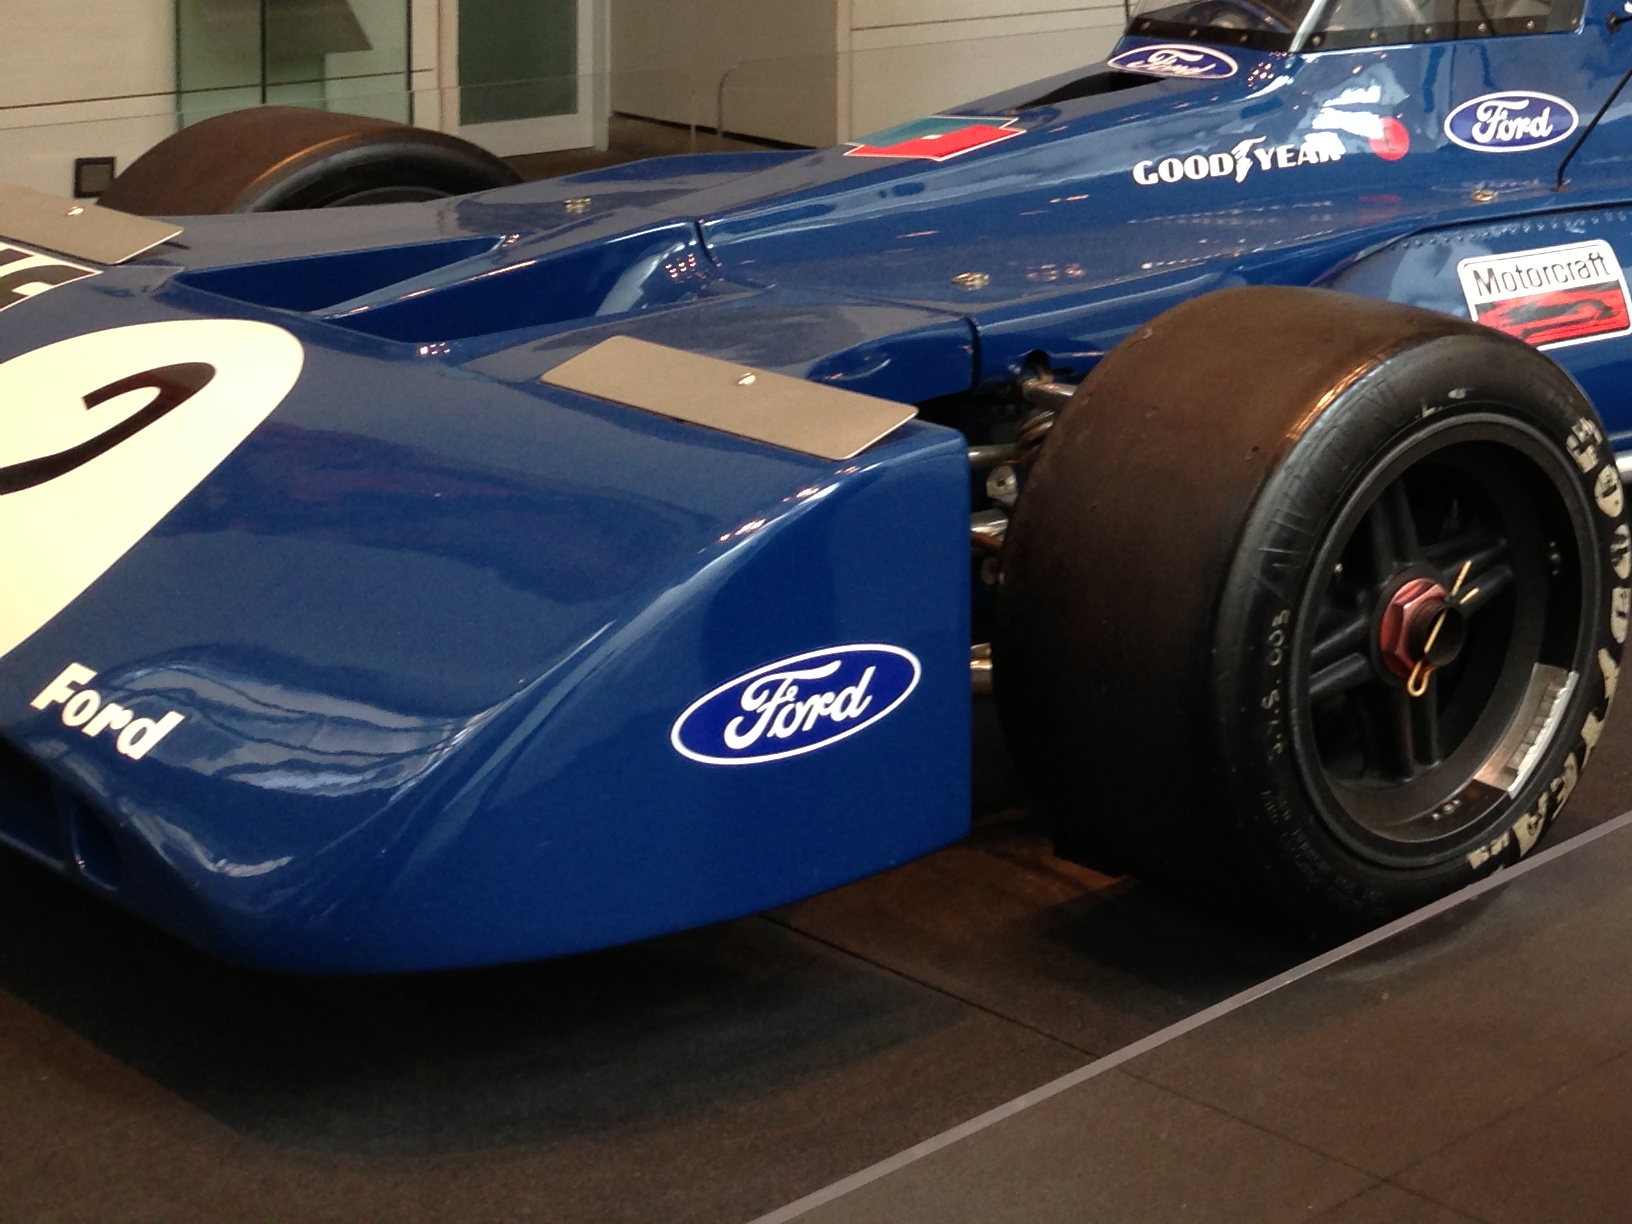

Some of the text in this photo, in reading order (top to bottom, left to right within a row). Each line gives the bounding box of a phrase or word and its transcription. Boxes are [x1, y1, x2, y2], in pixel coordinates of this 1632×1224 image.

[1472, 99, 1553, 143] Ford
[1473, 252, 1610, 296] Motorcraft
[29, 662, 186, 760] Ford
[724, 659, 877, 750] Ford
